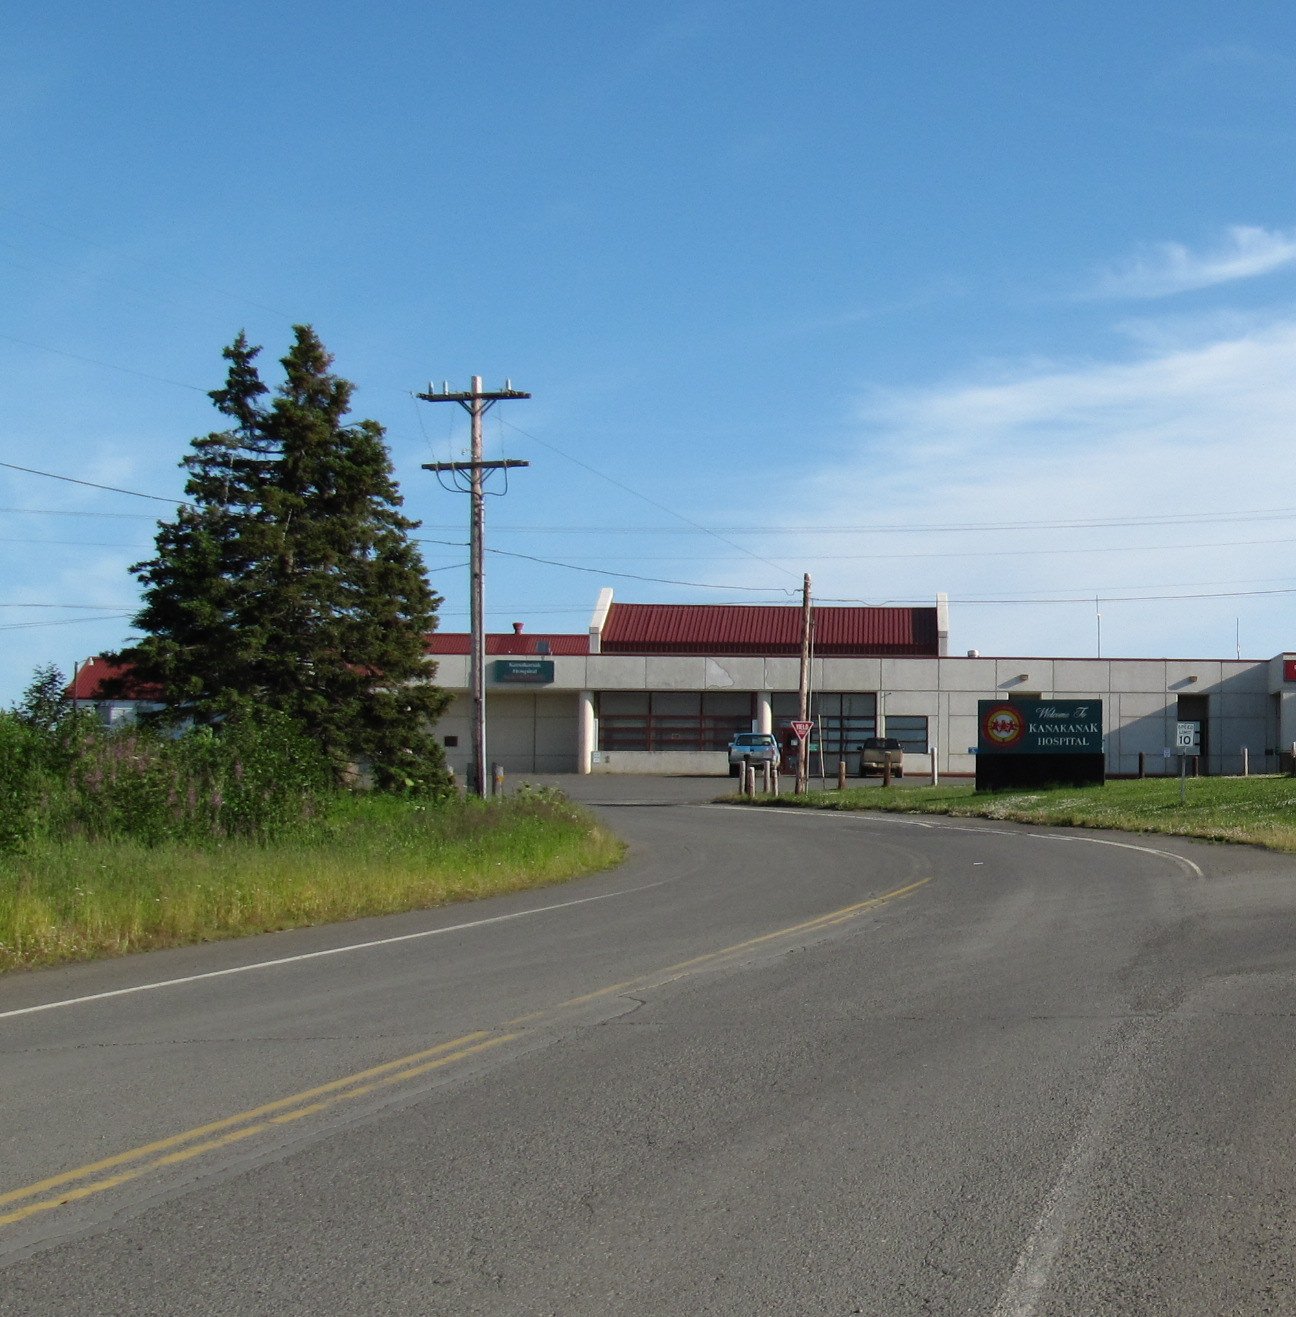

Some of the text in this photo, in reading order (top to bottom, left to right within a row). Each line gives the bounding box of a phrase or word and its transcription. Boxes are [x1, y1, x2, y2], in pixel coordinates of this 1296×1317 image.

[1028, 723, 1098, 733] KANAKANAK
[1037, 737, 1090, 746] HOSPITAL
[1179, 735, 1191, 746] 10
